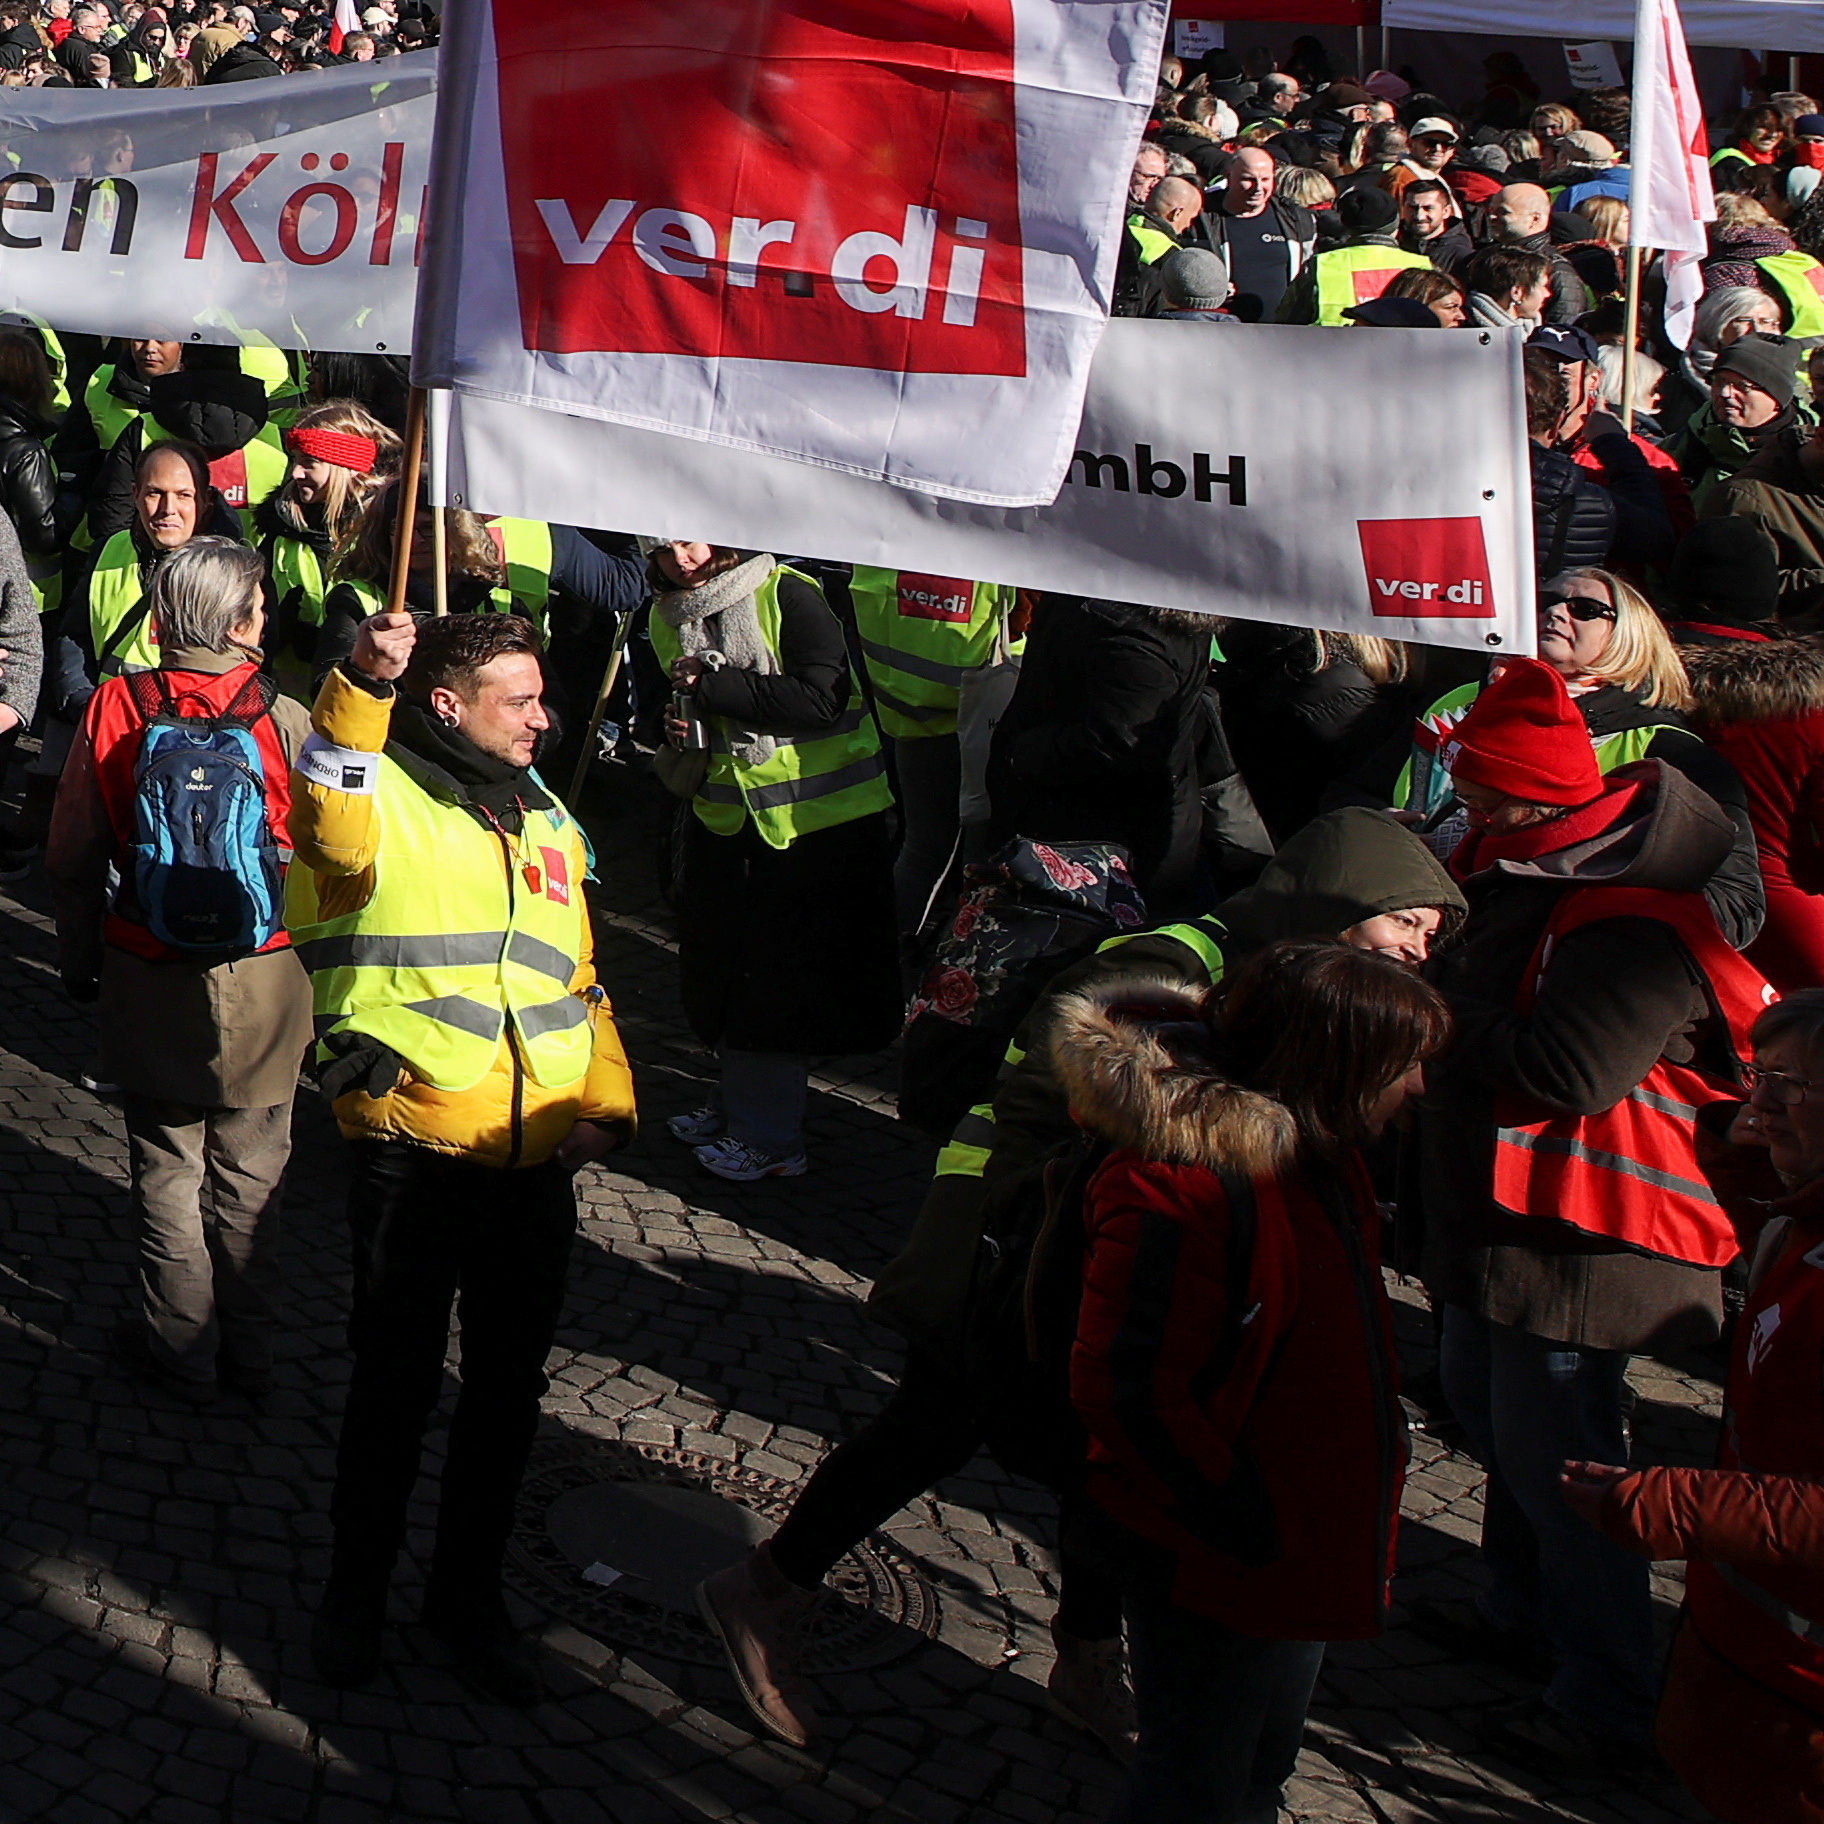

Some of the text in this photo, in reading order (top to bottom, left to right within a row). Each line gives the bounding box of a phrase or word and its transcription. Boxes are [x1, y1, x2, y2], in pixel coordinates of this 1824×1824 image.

[183, 141, 428, 267] Köl
[533, 197, 988, 327] ver.di
[1065, 443, 1248, 507] mbH
[901, 587, 967, 615] ver.di
[1374, 576, 1484, 606] ver.di
[185, 782, 213, 791] deuter
